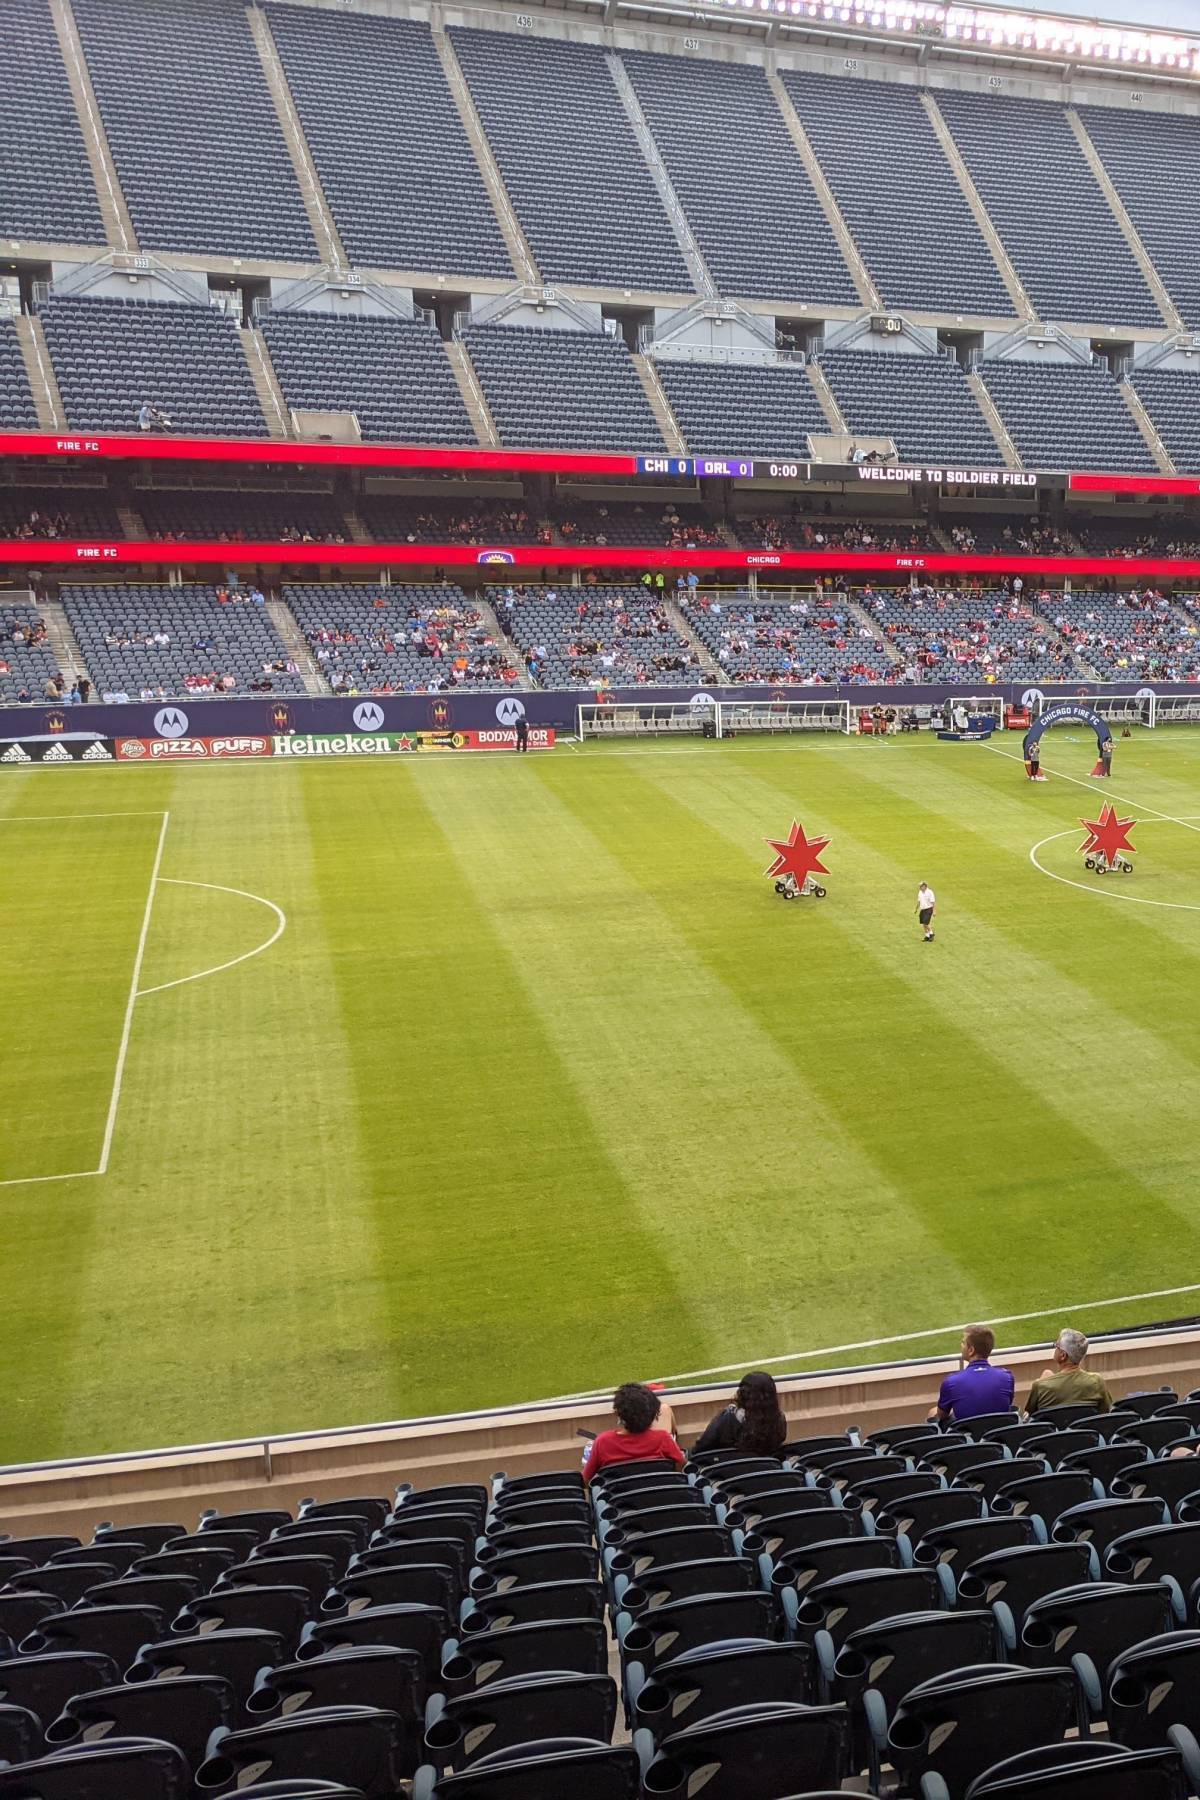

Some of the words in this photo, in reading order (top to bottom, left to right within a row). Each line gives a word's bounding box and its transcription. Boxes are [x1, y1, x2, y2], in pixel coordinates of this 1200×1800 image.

[517, 16, 533, 28] 436
[684, 38, 699, 49] 437
[844, 60, 858, 70] 438
[989, 77, 1002, 87] 439
[1130, 92, 1143, 102] 440
[348, 275, 360, 283] 334
[57, 442, 80, 450] FIRE
[85, 443, 99, 451] FC
[645, 460, 668, 472] CHI
[678, 461, 686, 472] 0
[704, 461, 731, 474] ORL
[739, 463, 748, 475] 0
[770, 464, 798, 477] 0:00
[858, 467, 921, 480] WELCOME
[926, 470, 940, 481] TO
[946, 471, 998, 484] SOLDIER
[1002, 473, 1037, 486] FIELD
[77, 549, 100, 557] FIRE
[104, 549, 117, 557] FC
[747, 556, 780, 564] CHICAGO
[915, 559, 925, 567] FC
[1040, 707, 1071, 726] CHICAGO
[1073, 707, 1091, 719] FIRE
[1089, 715, 1100, 725] FC
[151, 740, 207, 756] PIZZA
[211, 738, 265, 754] PUFF
[272, 733, 392, 755] Heineken
[1, 754, 32, 762] adidas
[42, 753, 74, 761] adidas
[82, 752, 112, 760] adidas
